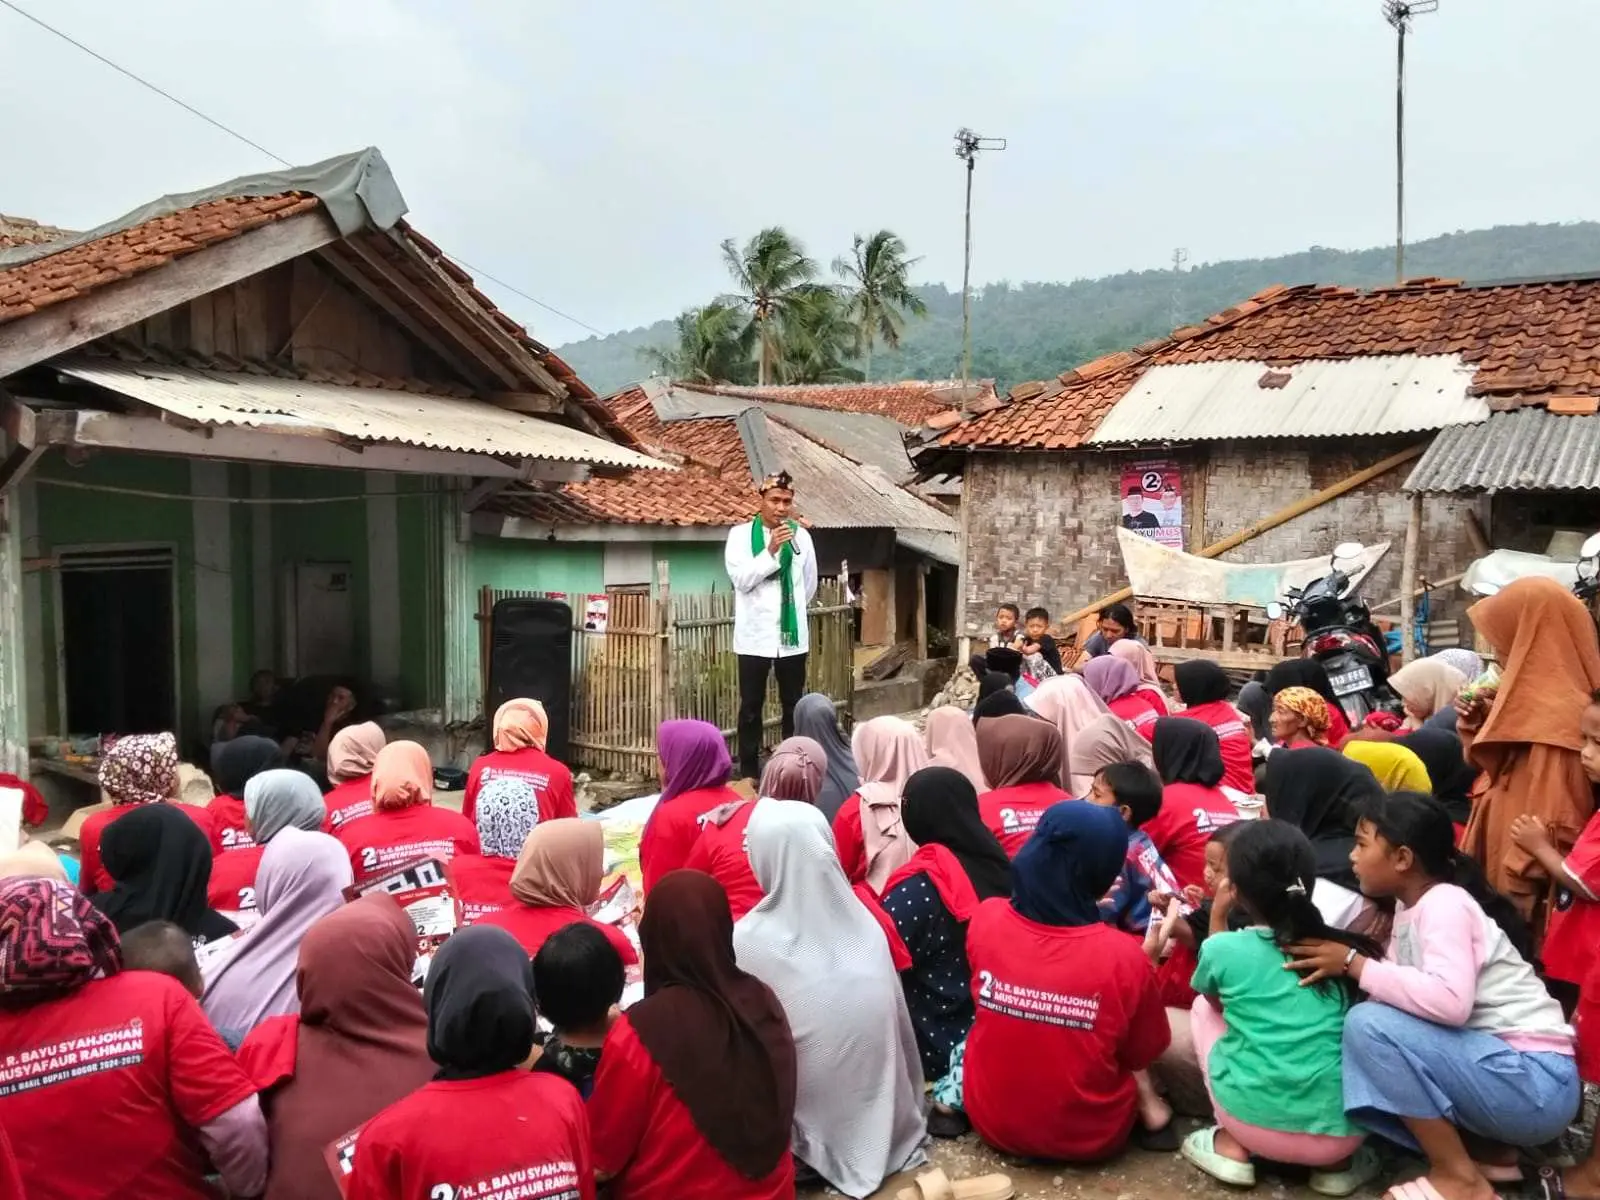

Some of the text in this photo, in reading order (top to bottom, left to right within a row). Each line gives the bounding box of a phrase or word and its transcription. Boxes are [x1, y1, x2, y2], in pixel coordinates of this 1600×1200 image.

[1145, 474, 1158, 488] 2
[331, 810, 342, 825] 2
[1000, 808, 1019, 826] 2
[1192, 808, 1210, 826] 2
[222, 828, 236, 845] 2
[361, 847, 377, 866] 2
[238, 887, 256, 908] 2
[418, 925, 426, 935] 2
[980, 970, 992, 998] 2
[1013, 986, 1040, 999] BAYU
[1040, 991, 1099, 1010] SYAHJOHAN
[994, 991, 1097, 1021] MUSYAFAUR RAHMAN
[6, 1028, 143, 1067] R. BAYU SYAHJOHAN
[80, 1039, 143, 1061] RAHMAN
[43, 1071, 70, 1085] BUPATI
[71, 1063, 98, 1078] BOGOR
[478, 1181, 491, 1193] R.
[492, 1171, 526, 1189] BAYU
